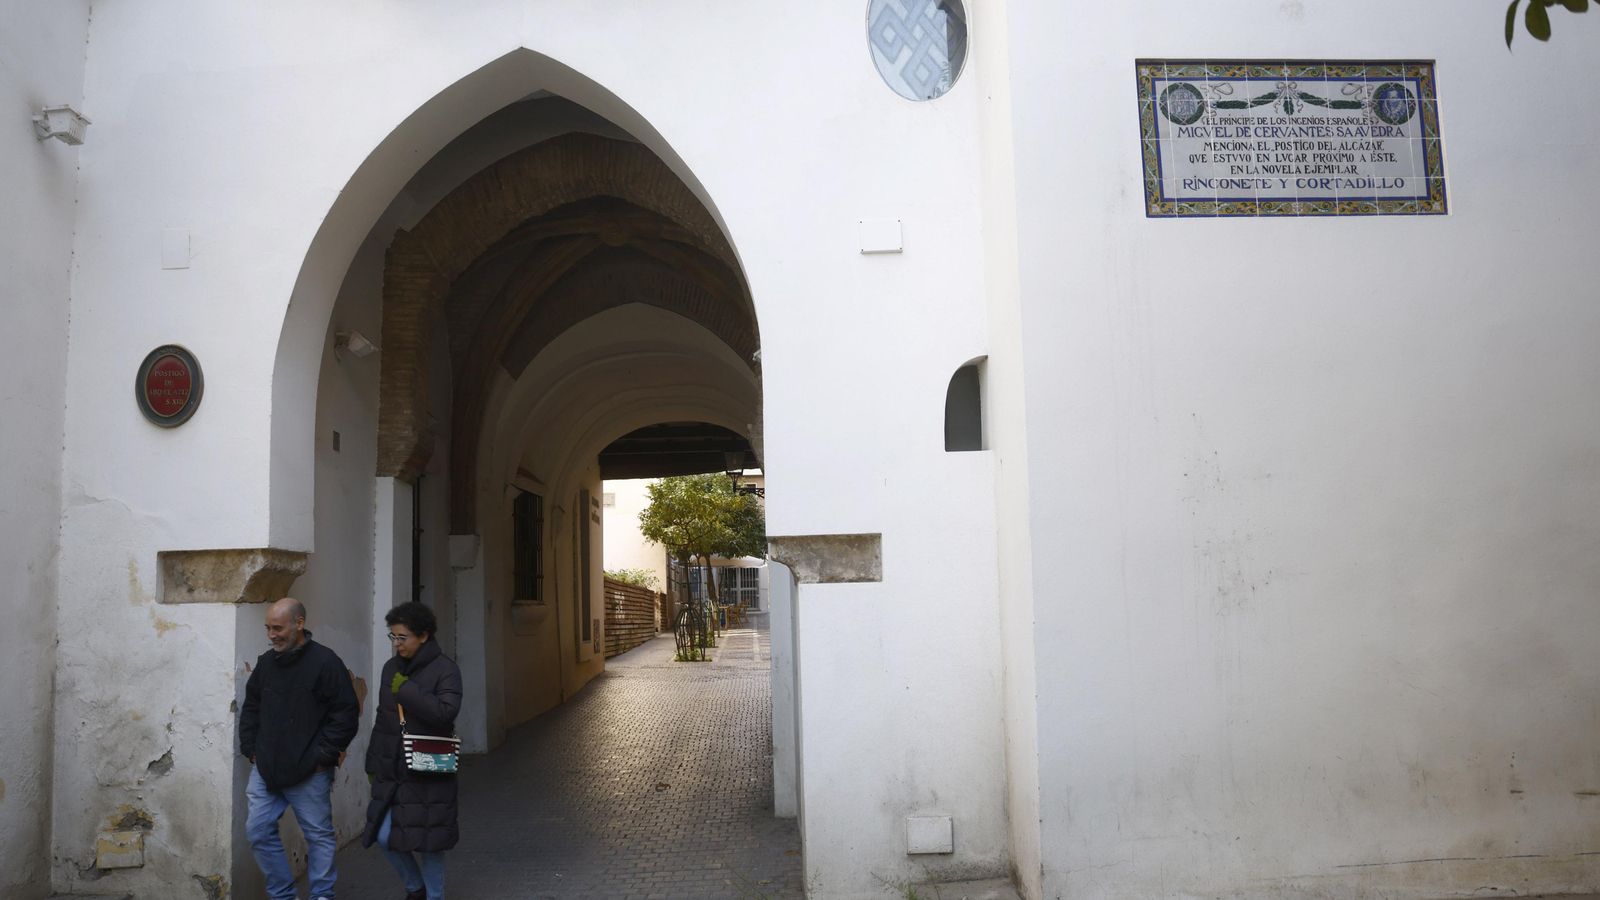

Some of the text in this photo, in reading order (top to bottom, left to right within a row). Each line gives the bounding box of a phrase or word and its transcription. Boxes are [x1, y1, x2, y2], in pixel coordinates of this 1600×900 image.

[1289, 115, 1325, 125] INGENIOS
[1327, 116, 1374, 125] ESPAÑOLES
[1236, 127, 1251, 138] DE
[1254, 126, 1334, 138] CERVANTES
[1337, 126, 1405, 137] SAAVEDRA
[1204, 140, 1255, 151] MENCIONA
[1257, 142, 1270, 151] EL
[1317, 142, 1336, 151] DEL
[1189, 154, 1207, 164] QVE
[1214, 154, 1252, 163] ESTVVO
[1257, 154, 1270, 163] EN
[1360, 154, 1366, 162] A
[1231, 163, 1359, 175] EN LA NOVELA EJEMPLAR
[1184, 175, 1405, 191] RINCONETE Y CORTADILLO
